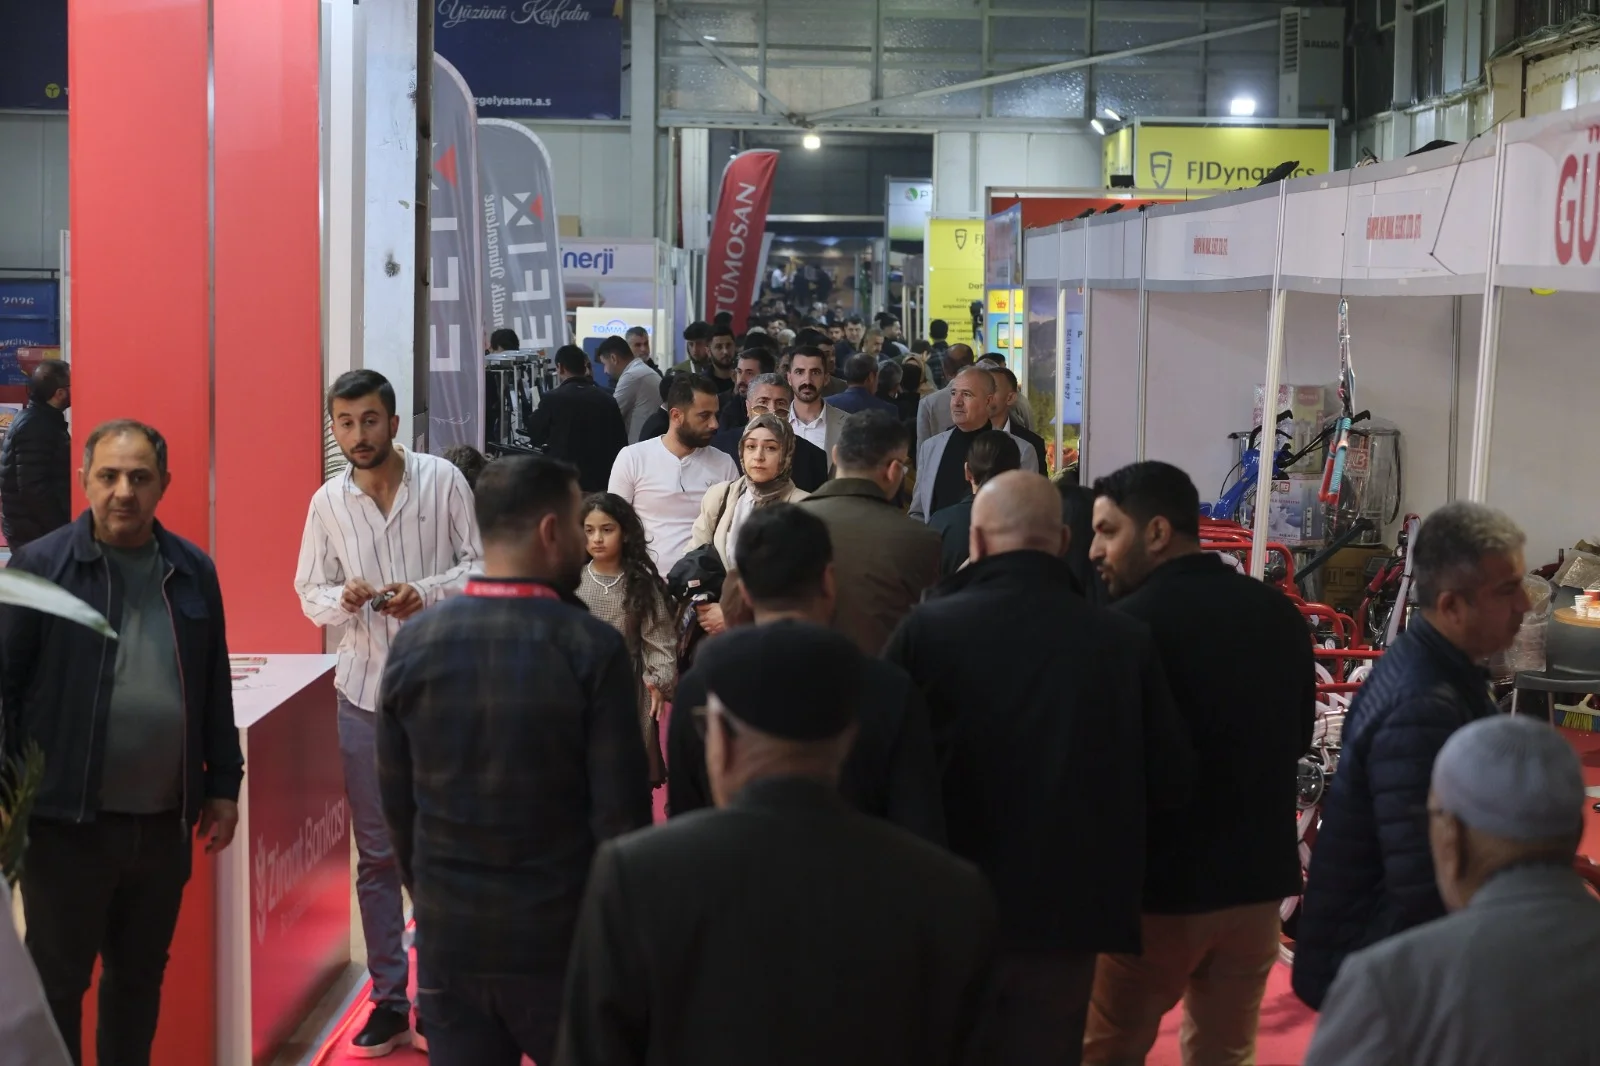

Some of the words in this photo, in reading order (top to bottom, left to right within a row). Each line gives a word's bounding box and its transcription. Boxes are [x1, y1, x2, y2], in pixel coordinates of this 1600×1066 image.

[1187, 161, 1315, 185] FJDynacs
[560, 247, 614, 275] nerji
[714, 182, 757, 317] TÜMOSAN
